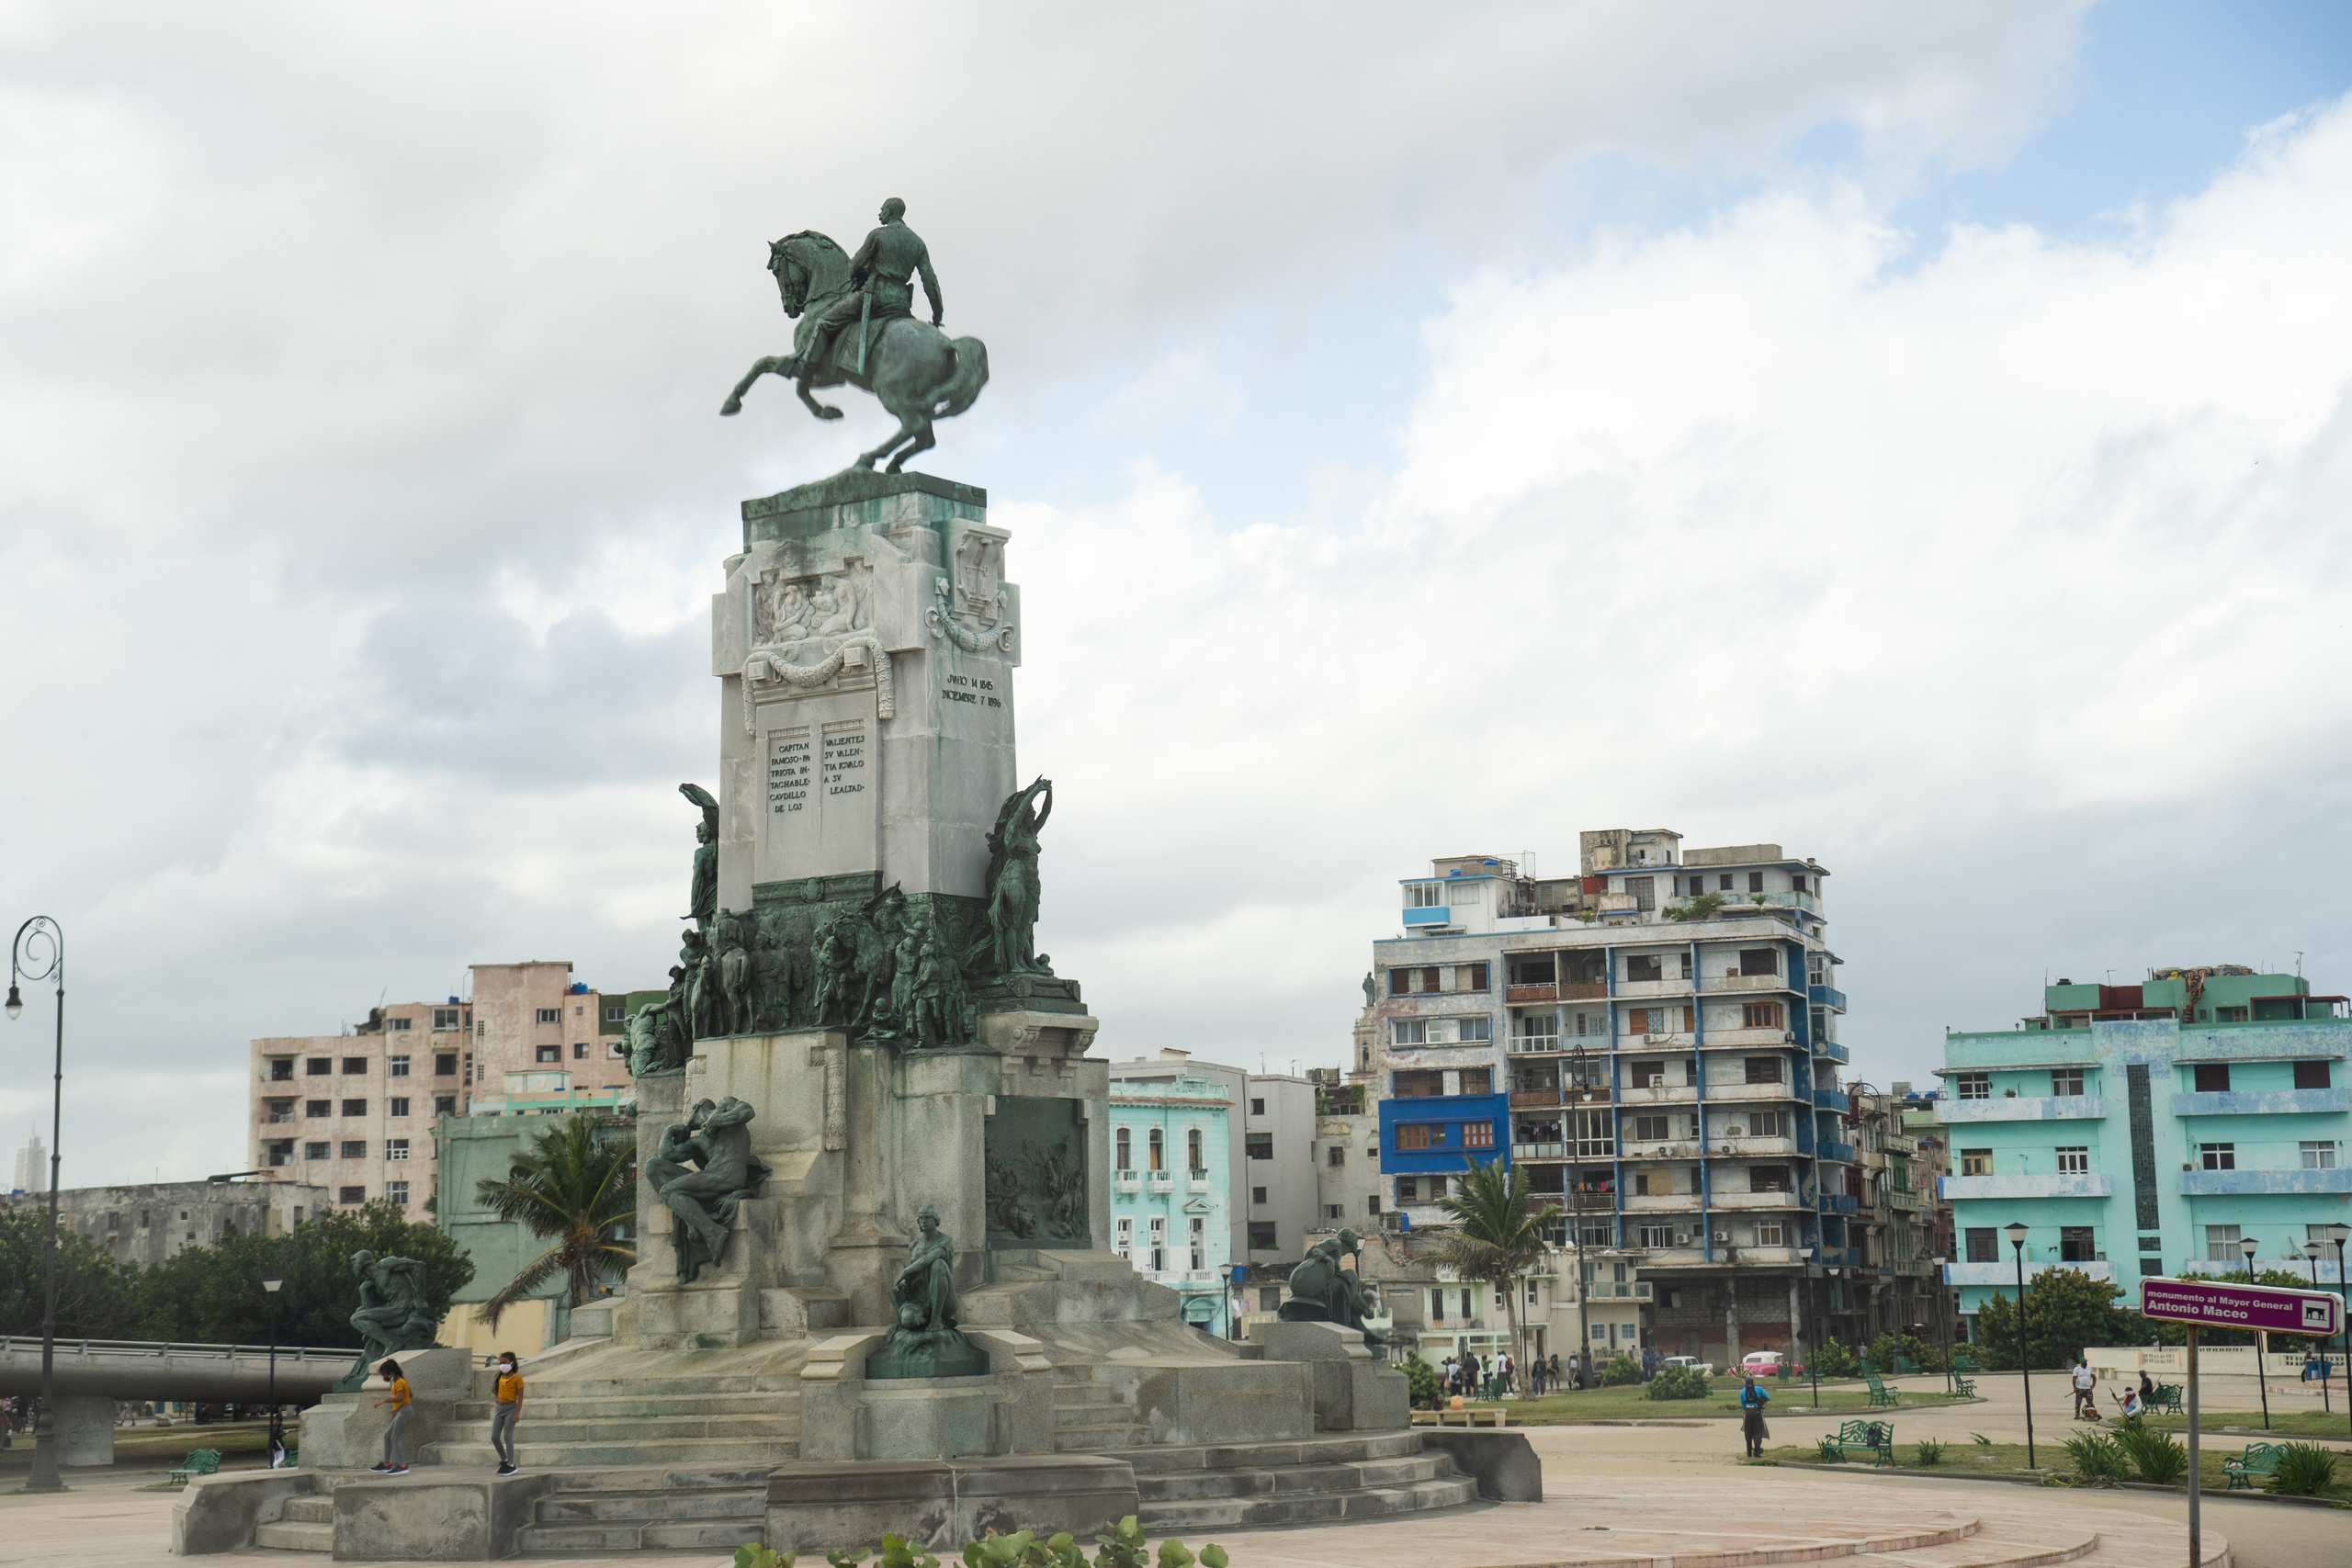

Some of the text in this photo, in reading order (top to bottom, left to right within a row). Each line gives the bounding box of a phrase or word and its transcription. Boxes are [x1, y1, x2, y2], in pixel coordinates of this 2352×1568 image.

[980, 696, 985, 705] 7
[826, 736, 865, 746] VALIENTES
[779, 742, 809, 752] CAPITAN
[771, 769, 796, 777] TRIOTA
[788, 803, 802, 811] LOS
[2148, 1291, 2204, 1302] monumento
[2220, 1297, 2250, 1307] Mayor
[2253, 1300, 2292, 1311] General
[2148, 1301, 2248, 1319] Antonio Maceo
